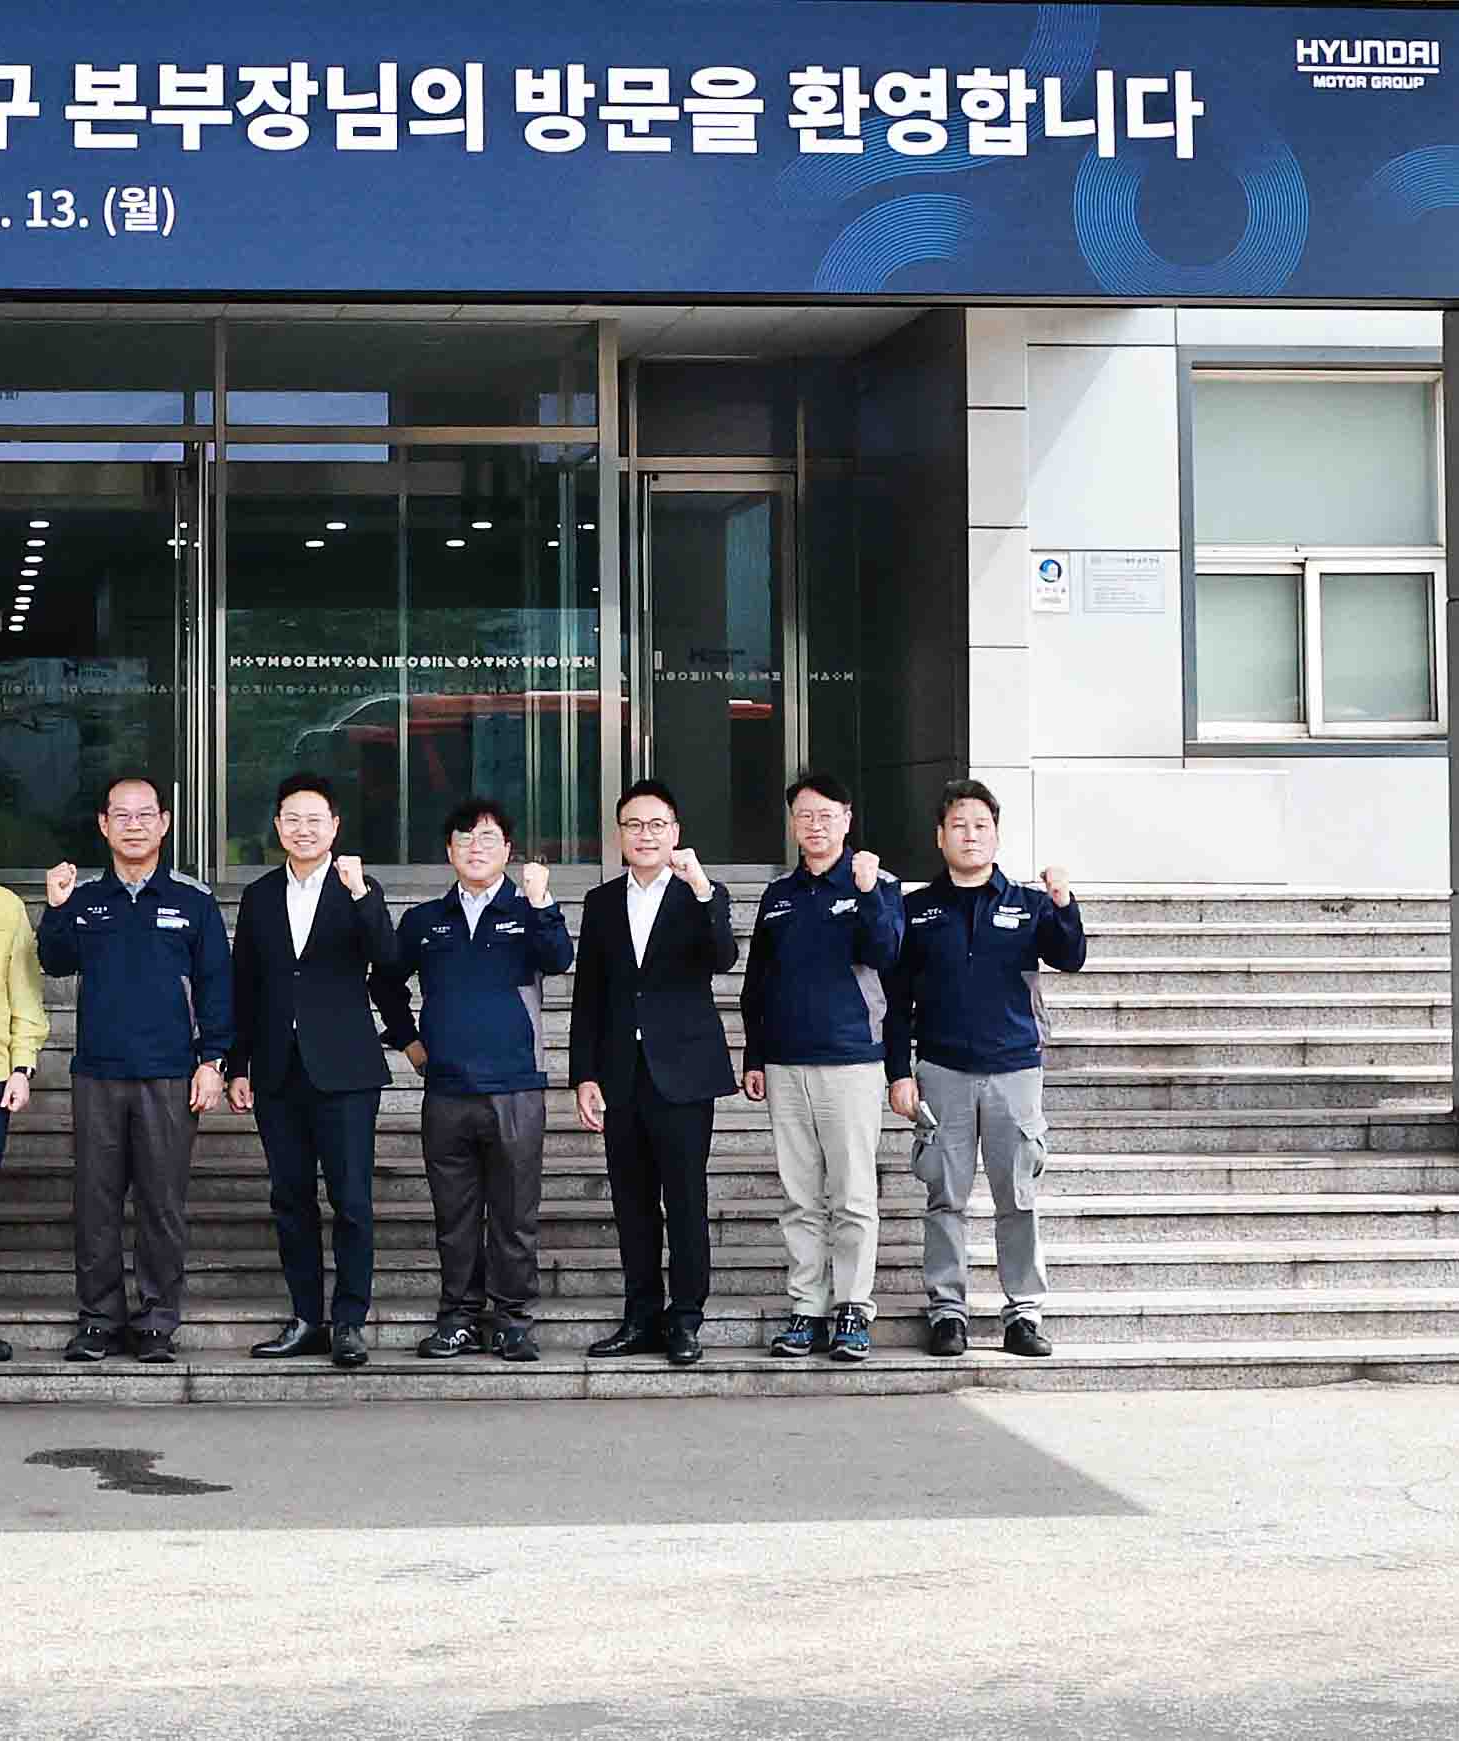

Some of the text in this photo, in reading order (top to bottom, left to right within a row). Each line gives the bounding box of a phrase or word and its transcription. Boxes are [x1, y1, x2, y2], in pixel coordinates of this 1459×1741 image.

[1296, 39, 1440, 65] HYUNDAI
[1313, 75, 1425, 89] MOTOR GROUP
[65, 62, 484, 152] 본부장님의
[515, 63, 764, 154] 방문을
[788, 66, 1204, 159] 환영합니다
[26, 189, 89, 228] 13.
[104, 186, 175, 237] (월)
